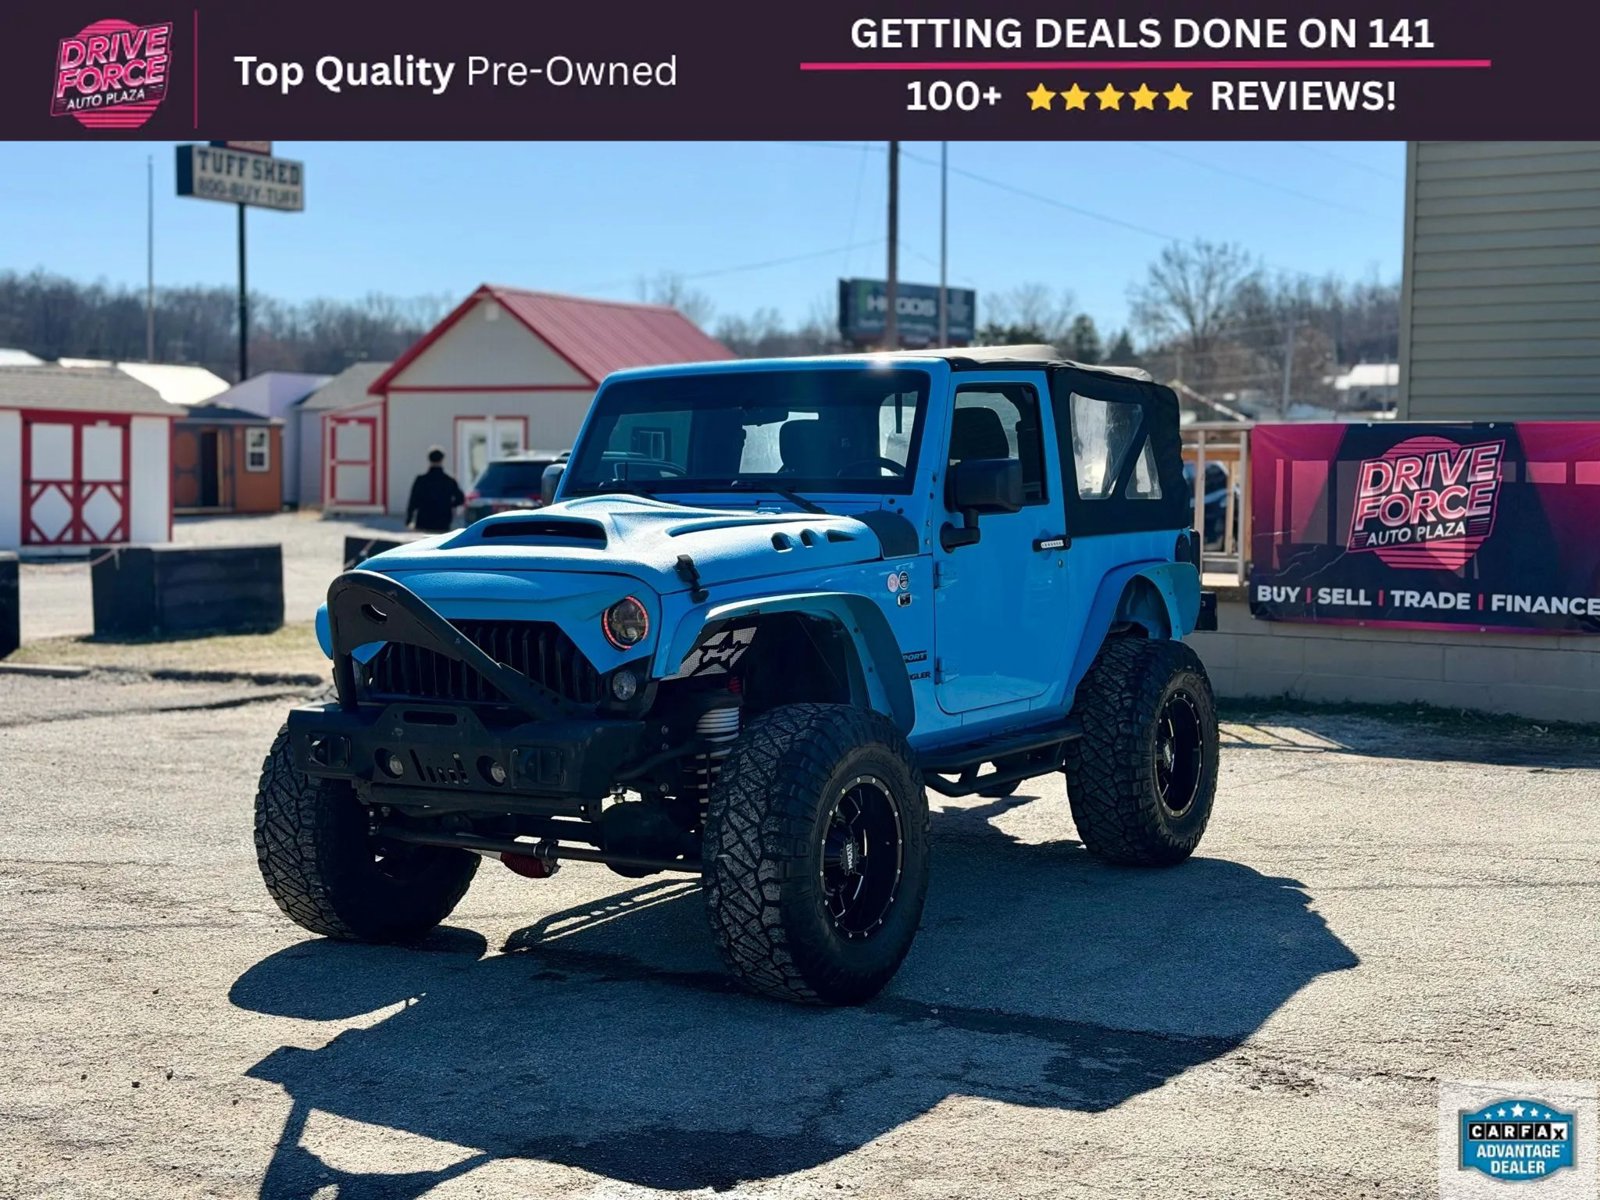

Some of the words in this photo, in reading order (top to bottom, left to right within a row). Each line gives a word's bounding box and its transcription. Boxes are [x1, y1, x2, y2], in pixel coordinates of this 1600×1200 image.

[198, 149, 248, 178] TUFF
[252, 159, 300, 186] SHED
[1360, 444, 1500, 499] DRIVE
[1354, 481, 1497, 531] FORCE
[1366, 527, 1412, 546] AUTO
[1415, 521, 1466, 542] PLAZA
[1257, 585, 1301, 603] BUY
[1317, 588, 1372, 606] SELL
[1390, 590, 1471, 610] TRADE
[1491, 594, 1600, 616] FINANCE
